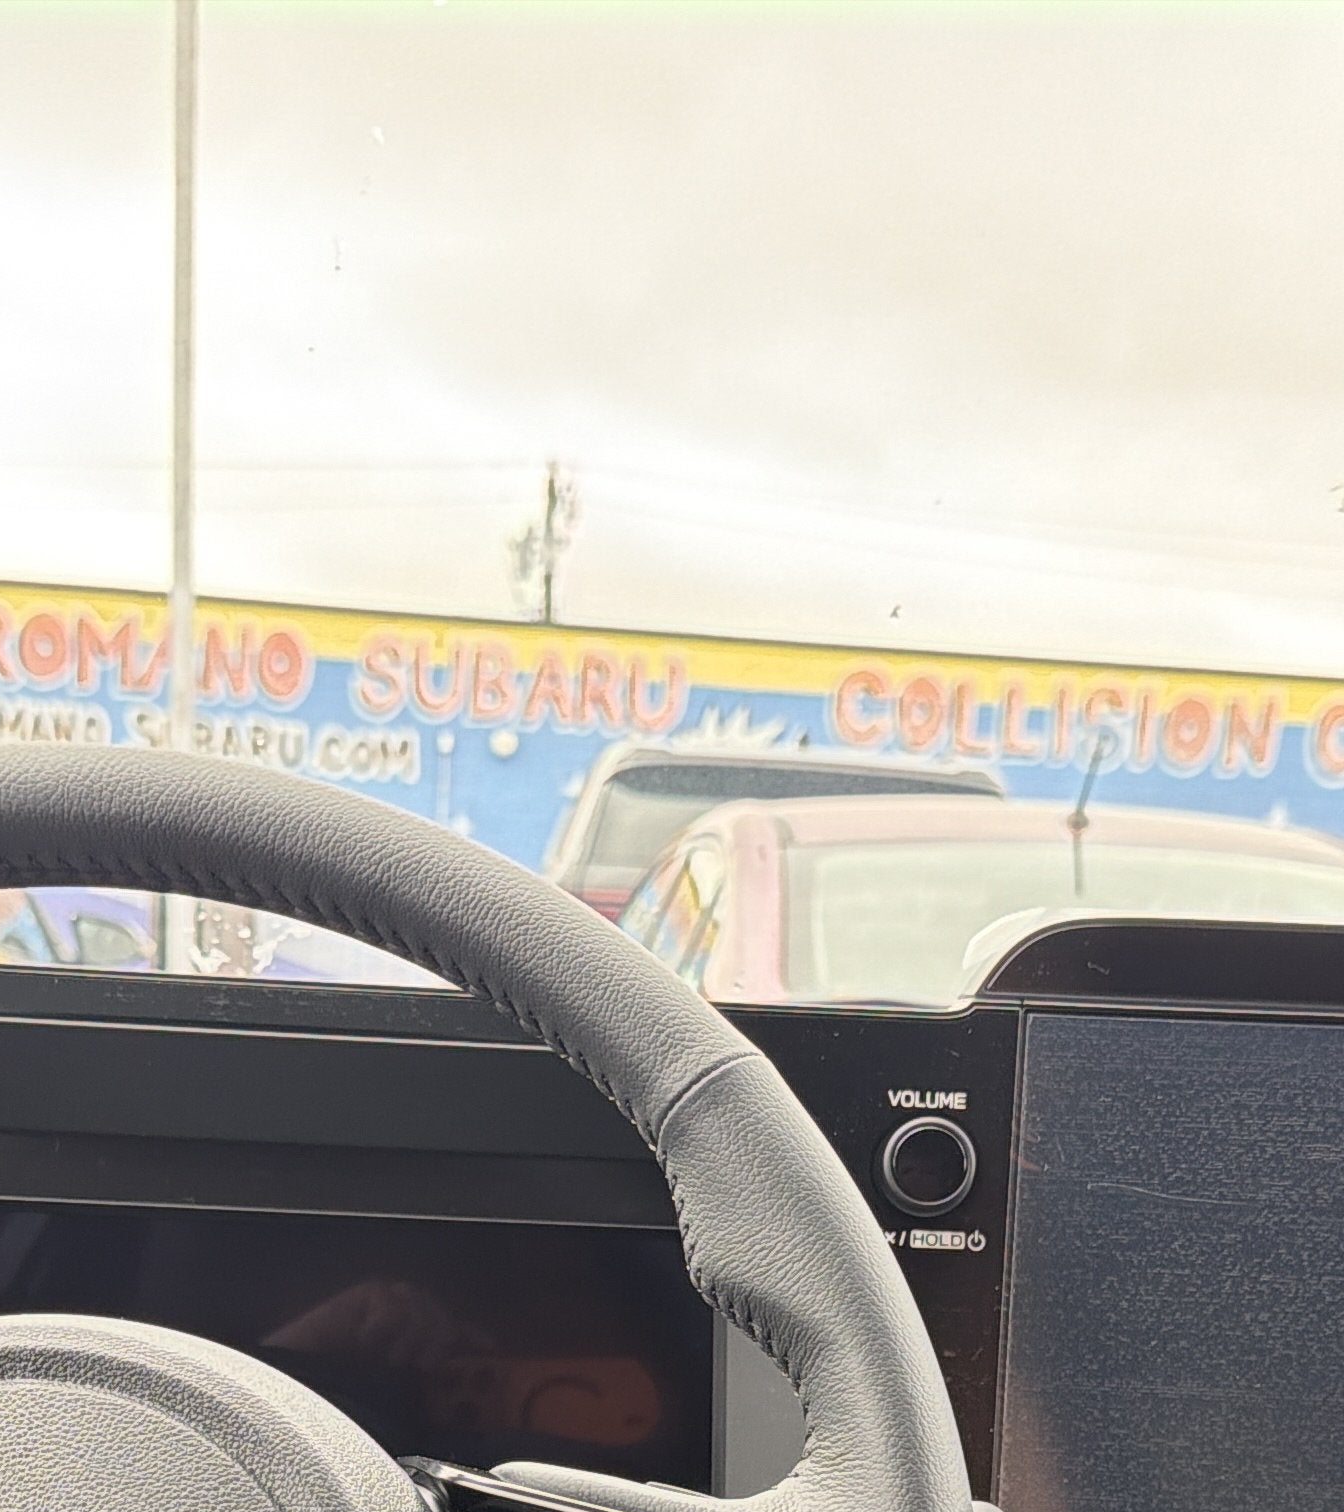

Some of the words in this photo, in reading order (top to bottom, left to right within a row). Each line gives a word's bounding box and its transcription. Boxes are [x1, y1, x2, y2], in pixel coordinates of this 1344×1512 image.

[360, 643, 681, 728] SUBARU
[834, 669, 1276, 767] COLLISION
[887, 1089, 968, 1110] VOLUME
[912, 1233, 963, 1247] HOLD
